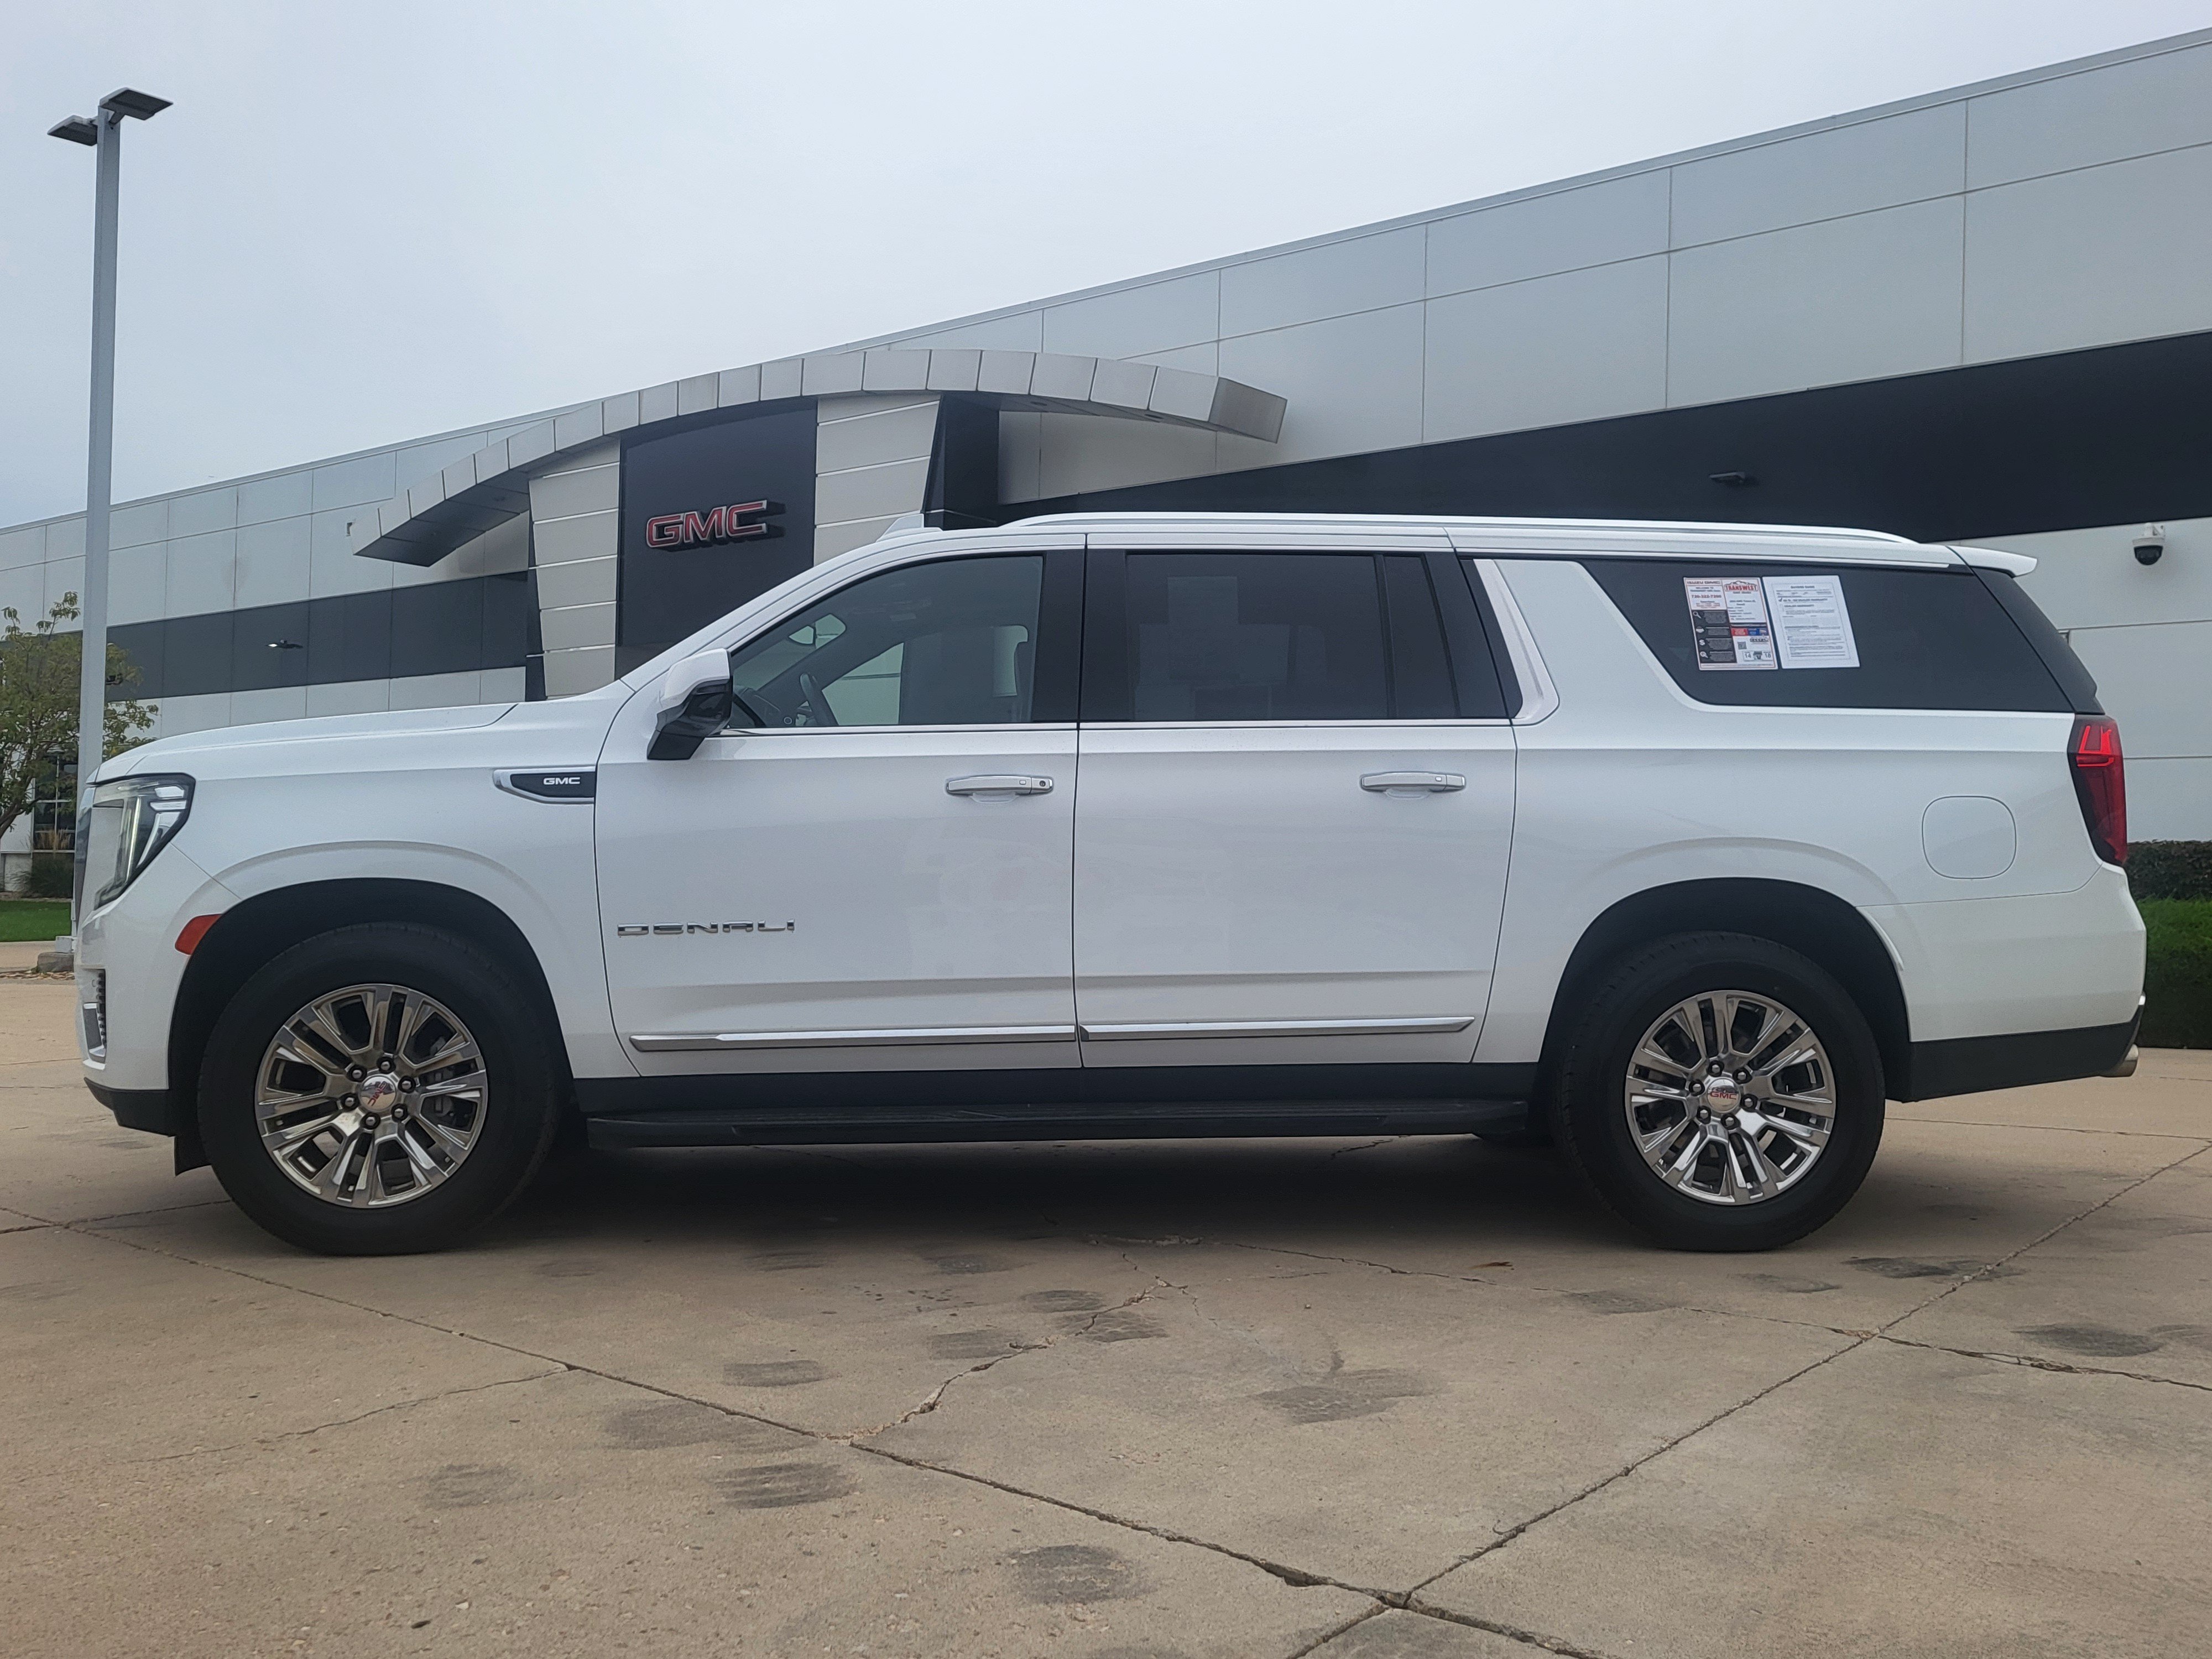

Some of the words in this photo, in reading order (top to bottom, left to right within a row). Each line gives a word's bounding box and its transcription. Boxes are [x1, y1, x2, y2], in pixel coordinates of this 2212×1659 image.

[646, 499, 768, 547] GMC
[543, 777, 581, 785] GMC
[617, 919, 795, 936] DENALI
[367, 1081, 387, 1107] GMC
[1710, 1091, 1738, 1100] GMC
